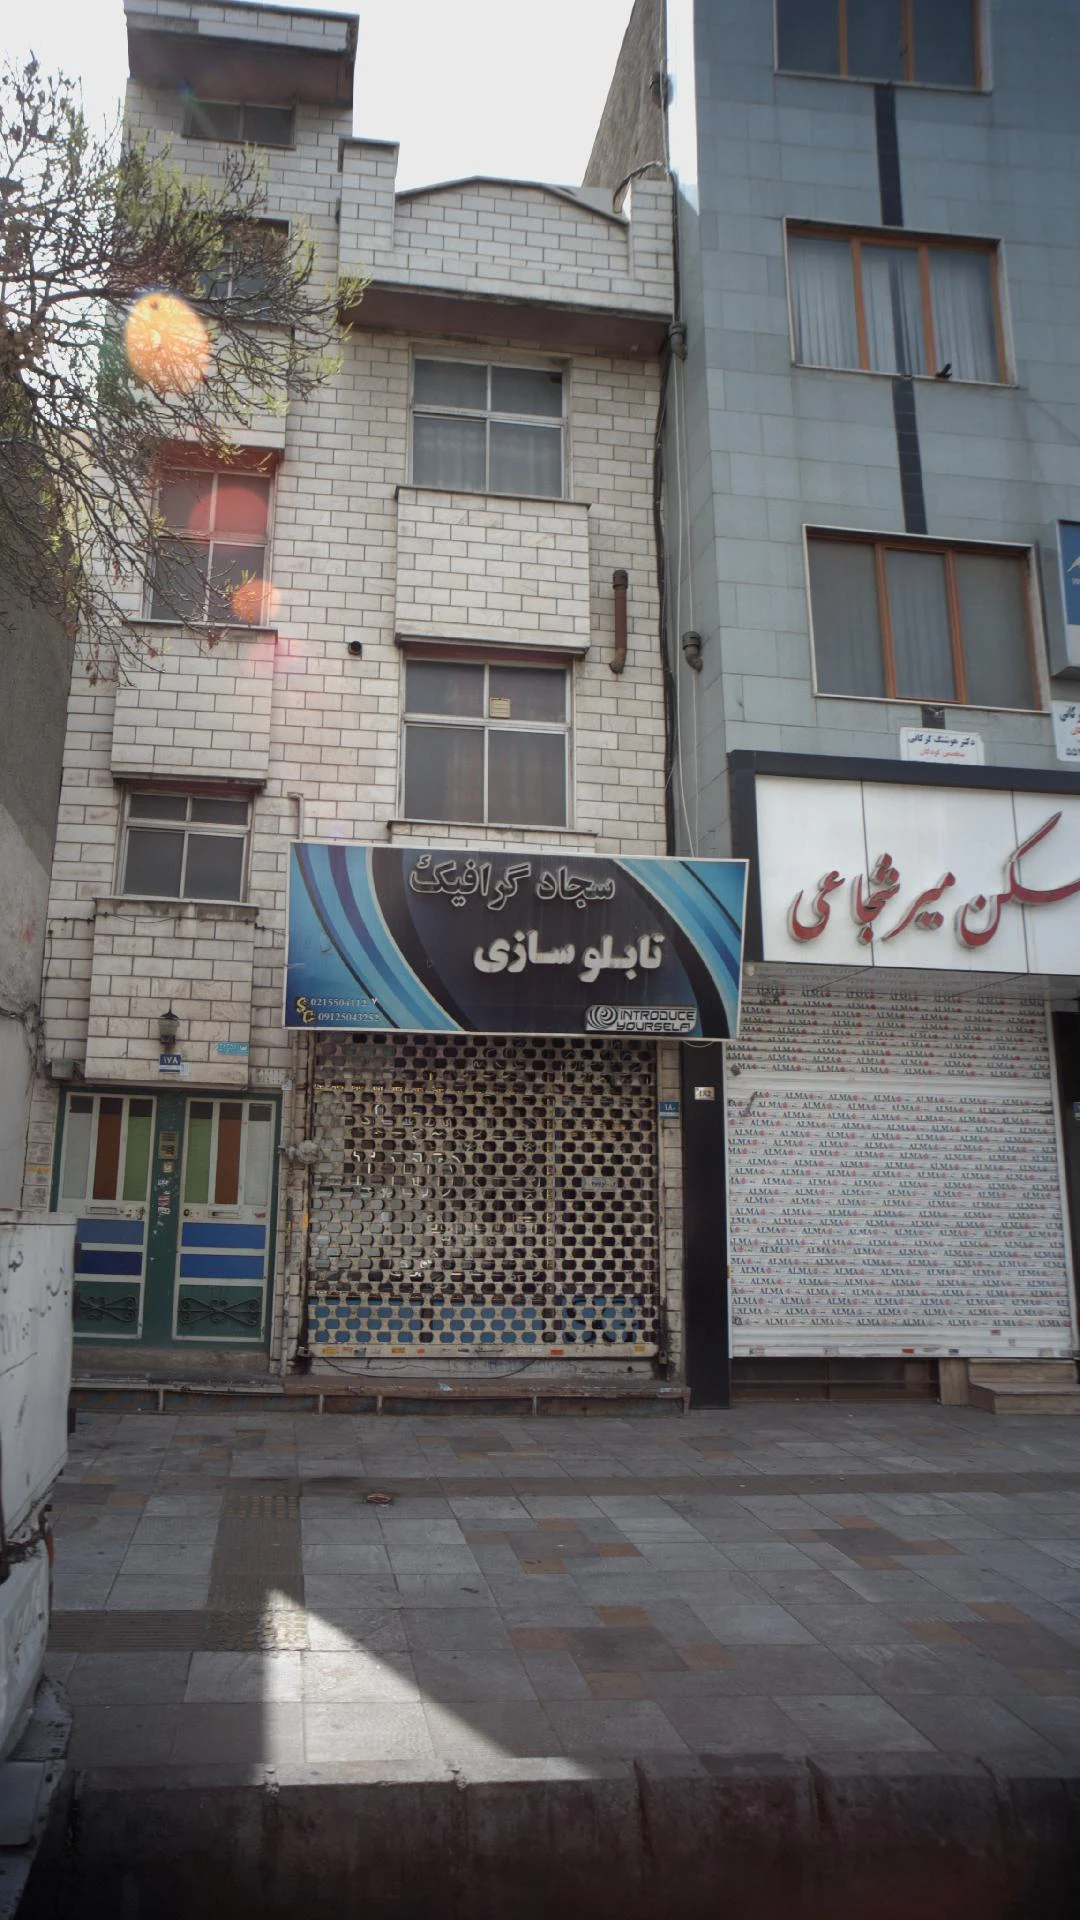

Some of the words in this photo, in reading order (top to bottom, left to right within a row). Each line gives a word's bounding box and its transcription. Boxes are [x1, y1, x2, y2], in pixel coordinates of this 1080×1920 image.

[536, 866, 616, 909] سجاد
[472, 929, 576, 973] سازی
[577, 932, 666, 983] تابلو
[802, 1000, 826, 1008] ALMA
[889, 1004, 914, 1012] ALMA
[620, 1010, 696, 1021] INTRODUCE
[786, 1008, 810, 1016] ALMA
[831, 1010, 855, 1018] ALMA
[875, 1012, 900, 1020] ALMA
[963, 1016, 987, 1024] ALMA
[817, 1047, 841, 1055] ALMA
[861, 1049, 885, 1057] ALMA
[948, 1052, 972, 1060] ALMA
[812, 1056, 836, 1064] ALMA
[856, 1058, 880, 1066] ALMA
[899, 1059, 923, 1067] ALMA
[771, 1064, 796, 1072] ALMA
[859, 1066, 884, 1074] ALMA
[903, 1068, 927, 1076] ALMA
[946, 1069, 970, 1077] ALMA
[784, 1092, 808, 1100] ALMA
[828, 1094, 853, 1102] ALMA
[915, 1096, 939, 1104] ALMA
[1000, 1099, 1025, 1107] ALMA
[758, 1101, 782, 1109] ALMA
[802, 1102, 827, 1110] ALMA
[847, 1103, 871, 1111] ALMA
[934, 1106, 958, 1114] ALMA
[827, 1112, 851, 1120] ALMA
[871, 1114, 895, 1122] ALMA
[914, 1115, 939, 1123] ALMA
[1001, 1117, 1025, 1125] ALMA
[750, 1119, 775, 1127] ALMA
[841, 1122, 866, 1130] ALMA
[930, 1125, 955, 1133] ALMA
[1018, 1127, 1042, 1135] ALMA
[780, 1130, 804, 1138] ALMA
[871, 1133, 895, 1141] ALMA
[915, 1134, 939, 1142] ALMA
[959, 1135, 983, 1143] ALMA
[727, 1138, 751, 1146] ALMA
[819, 1140, 843, 1148] ALMA
[909, 1143, 933, 1151] ALMA
[997, 1145, 1021, 1153] ALMA
[809, 1149, 833, 1157] ALMA
[854, 1151, 878, 1159] ALMA
[899, 1152, 923, 1160] ALMA
[987, 1154, 1011, 1162] ALMA
[747, 1158, 771, 1166] ALMA
[839, 1160, 864, 1168] ALMA
[929, 1163, 954, 1171] ALMA
[1018, 1165, 1042, 1173] ALMA
[781, 1168, 805, 1176] ALMA
[826, 1170, 851, 1178] ALMA
[872, 1170, 896, 1178] ALMA
[960, 1172, 985, 1180] ALMA
[762, 1178, 786, 1186] ALMA
[853, 1180, 877, 1188] ALMA
[943, 1182, 967, 1190] ALMA
[1030, 1184, 1055, 1192] ALMA
[748, 1188, 772, 1196] ALMA
[795, 1188, 819, 1196] ALMA
[887, 1189, 911, 1197] ALMA
[977, 1191, 1001, 1199] ALMA
[744, 1196, 768, 1204] ALMA
[836, 1198, 861, 1206] ALMA
[927, 1200, 951, 1208] ALMA
[1015, 1202, 1039, 1210] ALMA
[781, 1208, 806, 1216] ALMA
[827, 1209, 852, 1217] ALMA
[873, 1210, 897, 1218] ALMA
[962, 1211, 987, 1219] ALMA
[773, 1218, 797, 1226] ALMA
[819, 1219, 843, 1227] ALMA
[865, 1220, 889, 1228] ALMA
[955, 1221, 979, 1229] ALMA
[802, 1227, 827, 1235] ALMA
[893, 1228, 918, 1236] ALMA
[983, 1230, 1007, 1238] ALMA
[1028, 1230, 1052, 1238] ALMA
[868, 1240, 892, 1248] ALMA
[913, 1240, 937, 1248] ALMA
[958, 1240, 983, 1248] ALMA
[898, 1248, 922, 1256] ALMA
[943, 1250, 968, 1258] ALMA
[988, 1250, 1012, 1258] ALMA
[768, 1258, 792, 1266] ALMA
[861, 1259, 886, 1267] ALMA
[907, 1259, 932, 1267] ALMA
[952, 1260, 977, 1268] ALMA
[834, 1268, 858, 1276] ALMA
[880, 1268, 905, 1276] ALMA
[971, 1269, 996, 1277] ALMA
[751, 1278, 775, 1286] ALMA
[844, 1278, 868, 1286] ALMA
[936, 1279, 960, 1287] ALMA
[805, 1288, 830, 1296] ALMA
[896, 1289, 920, 1297] ALMA
[940, 1289, 965, 1297] ALMA
[985, 1290, 1009, 1298] ALMA
[827, 1298, 851, 1306] ALMA
[920, 1298, 944, 1306] ALMA
[877, 1308, 901, 1316] ALMA
[923, 1308, 947, 1316] ALMA
[968, 1308, 992, 1316] ALMA
[765, 1318, 789, 1326] ALMA
[856, 1318, 880, 1326] ALMA
[947, 1319, 971, 1327] ALMA
[1037, 1320, 1061, 1328] ALMA
